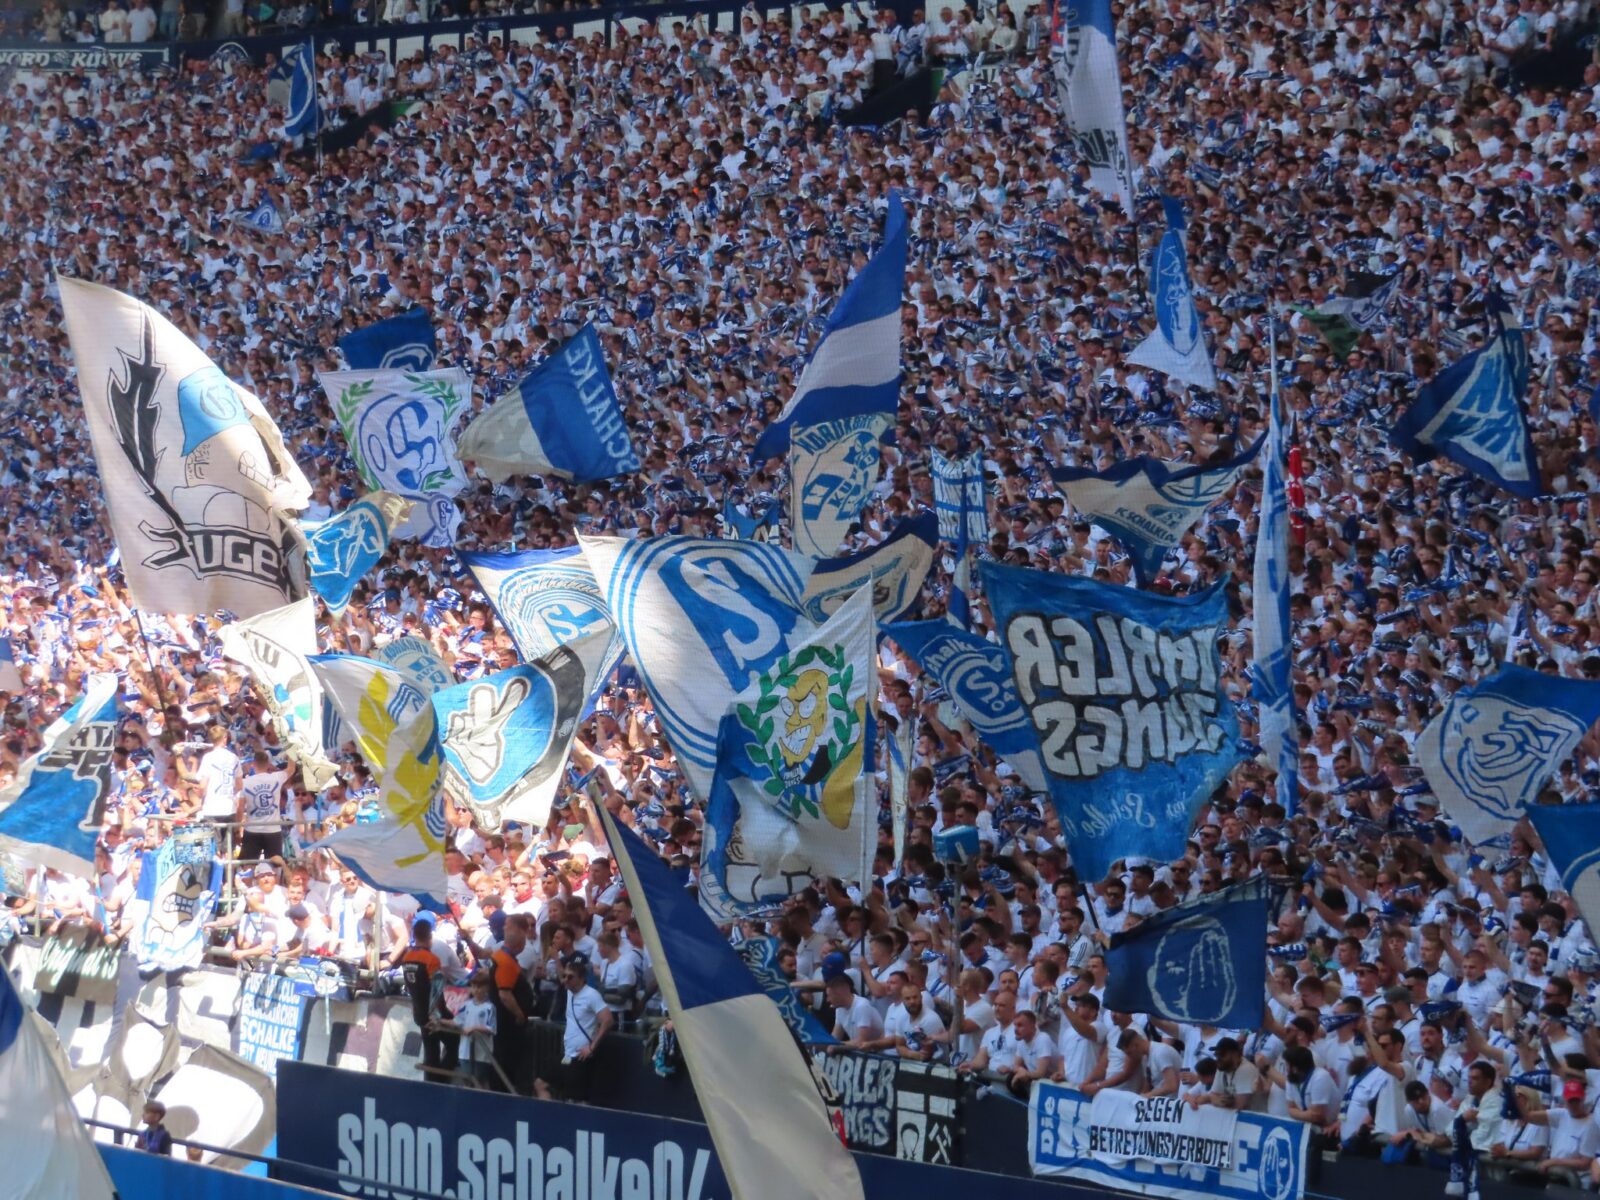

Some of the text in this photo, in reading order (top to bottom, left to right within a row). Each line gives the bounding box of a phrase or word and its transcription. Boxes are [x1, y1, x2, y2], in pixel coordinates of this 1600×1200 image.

[240, 1015, 297, 1053] SCHALKE
[843, 1105, 891, 1147] NGS
[1134, 1095, 1185, 1124] GEGEN
[1089, 1125, 1233, 1169] BETRETUNGSVERBOTE!
